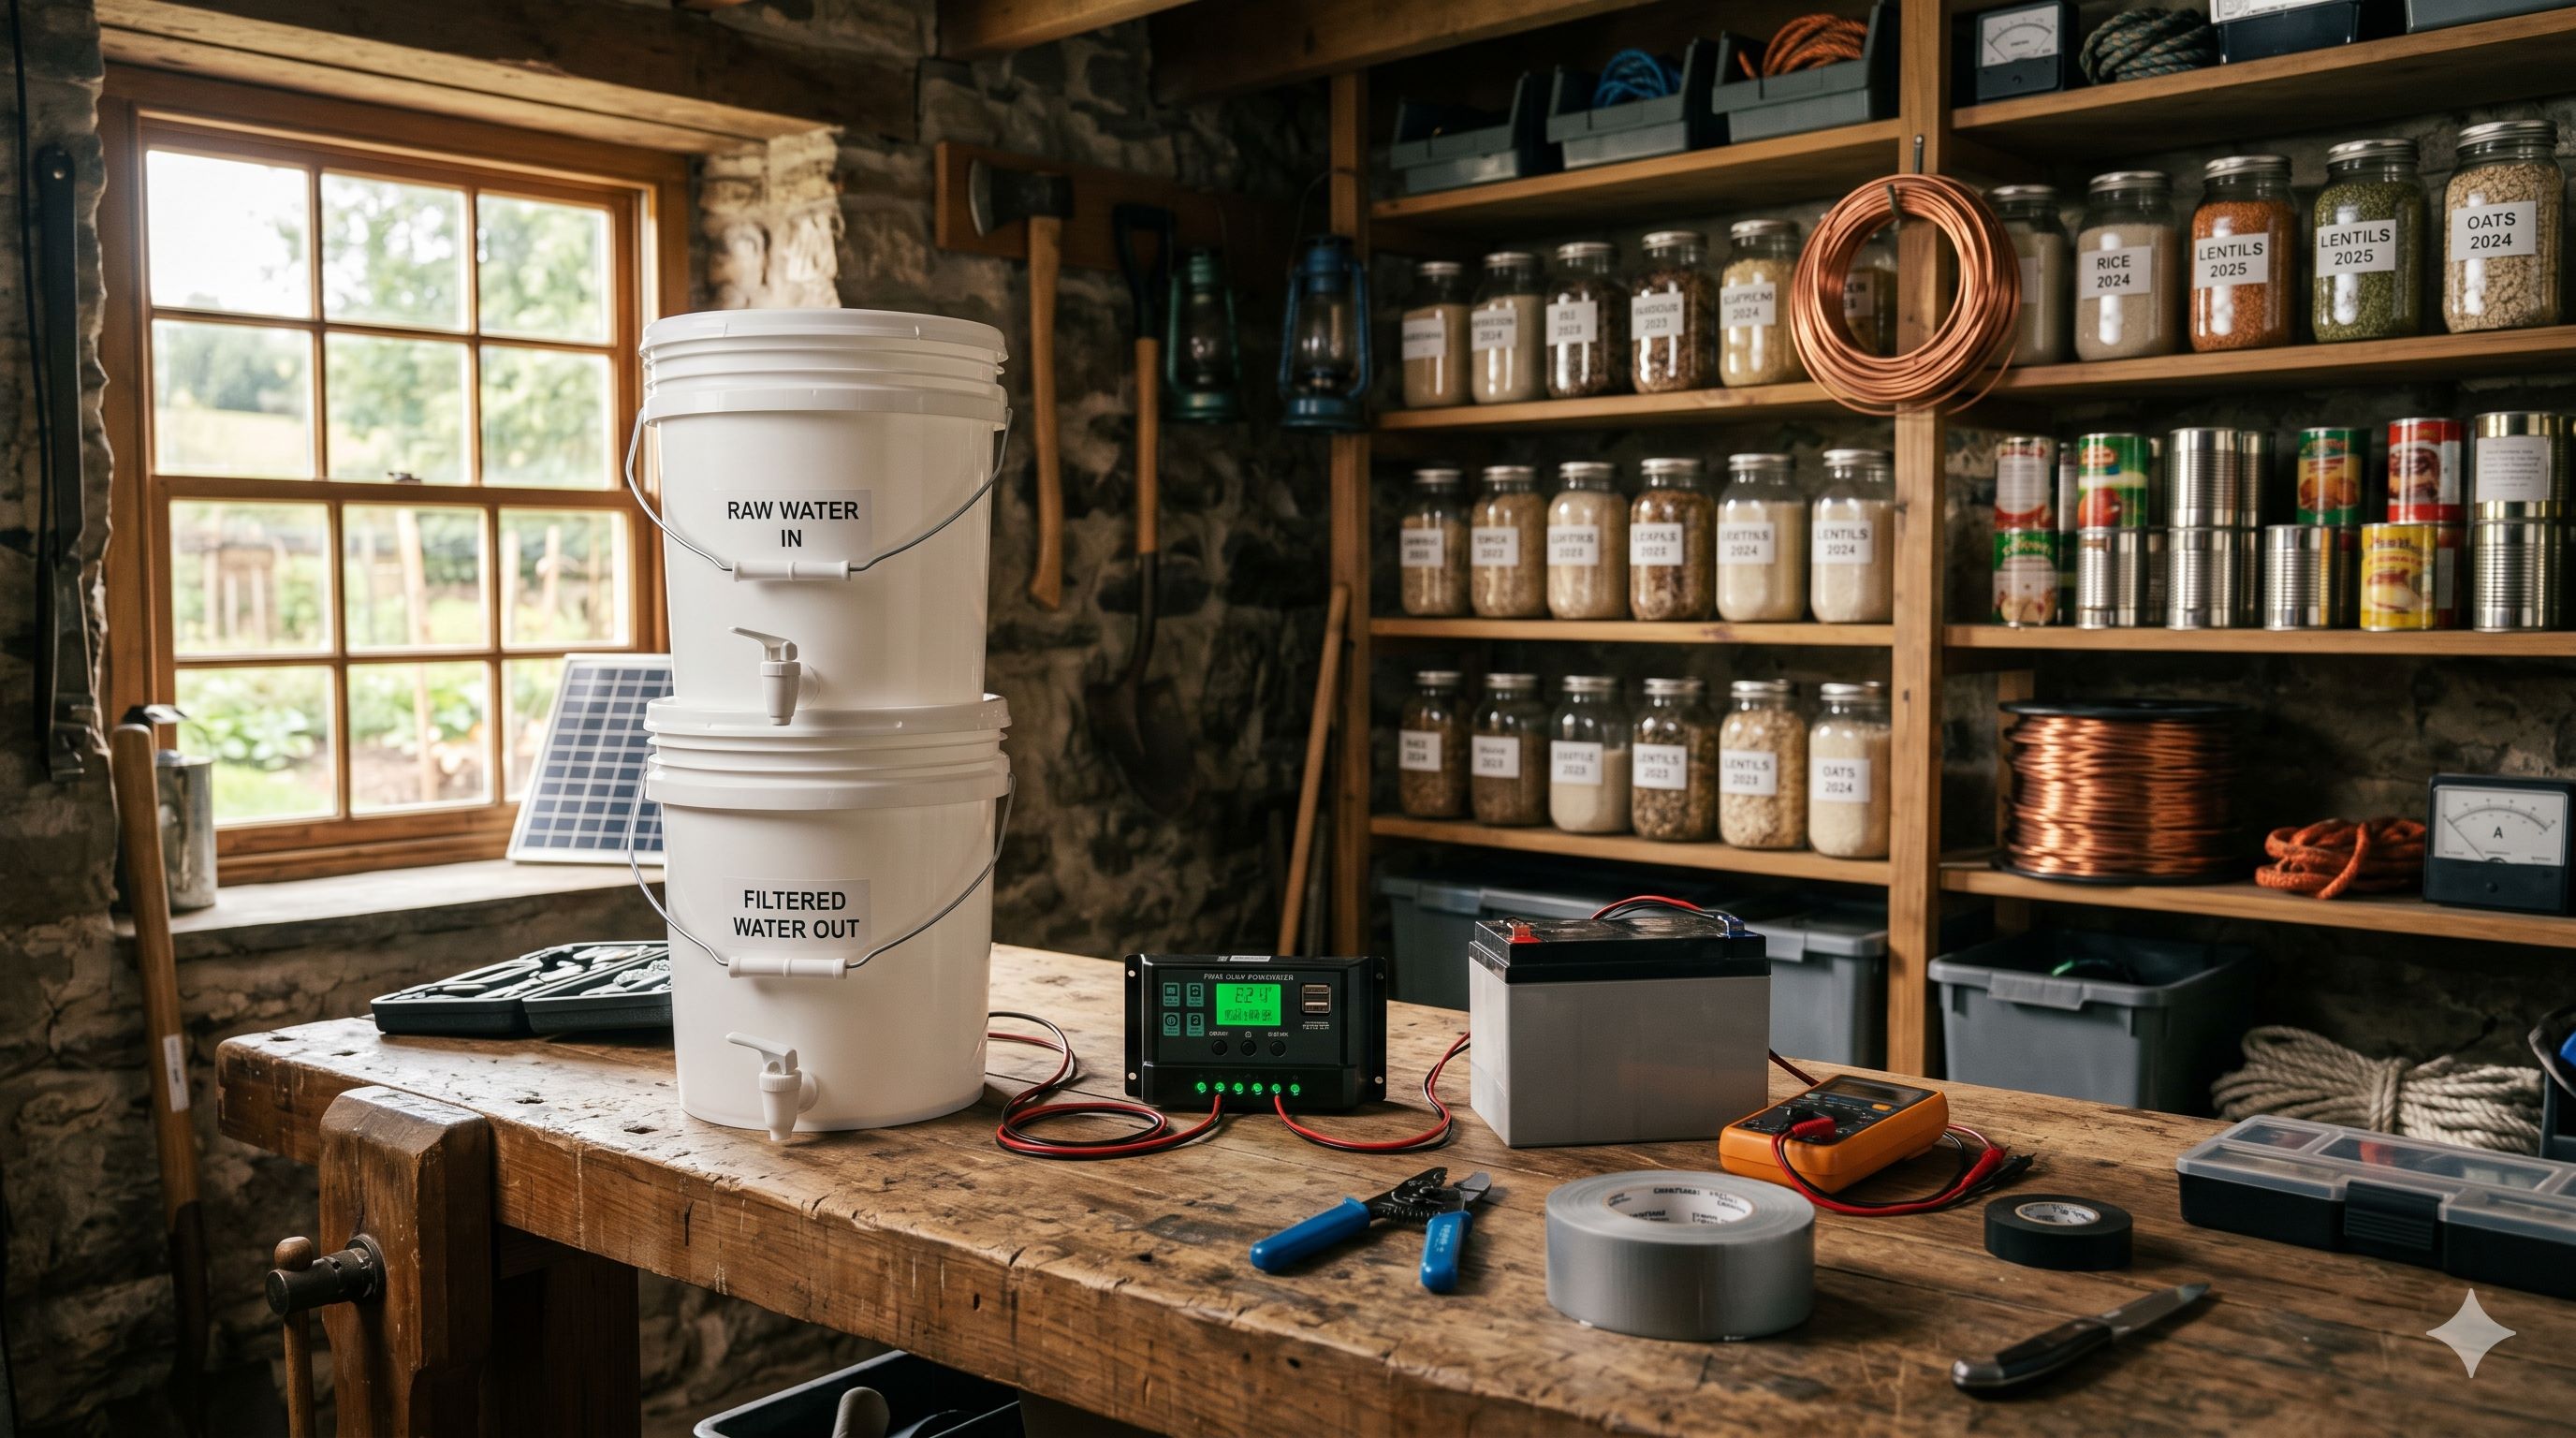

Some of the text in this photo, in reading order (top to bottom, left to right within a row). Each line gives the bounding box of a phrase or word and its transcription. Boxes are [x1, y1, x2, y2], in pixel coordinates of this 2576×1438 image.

[2467, 212, 2516, 230] OATS
[2320, 228, 2391, 248] LENTILS
[2470, 233, 2512, 250] 2024
[2199, 242, 2264, 261] LENTILS
[2334, 249, 2374, 266] 2025
[2097, 255, 2131, 271] RICE
[2210, 262, 2247, 278] 2025
[2097, 273, 2131, 289] 2024
[727, 501, 859, 520] RAW WATER
[781, 529, 802, 548] IN
[1817, 528, 1868, 541] LENTILS
[1730, 545, 1758, 557] 2024
[1826, 544, 1855, 555] 2024
[1724, 758, 1770, 771] LENTILS
[1822, 766, 1855, 779] OATS
[1825, 782, 1853, 794] 2024
[2493, 827, 2504, 839] A
[744, 889, 846, 911] FILTERED
[733, 917, 860, 939] WATER OUT
